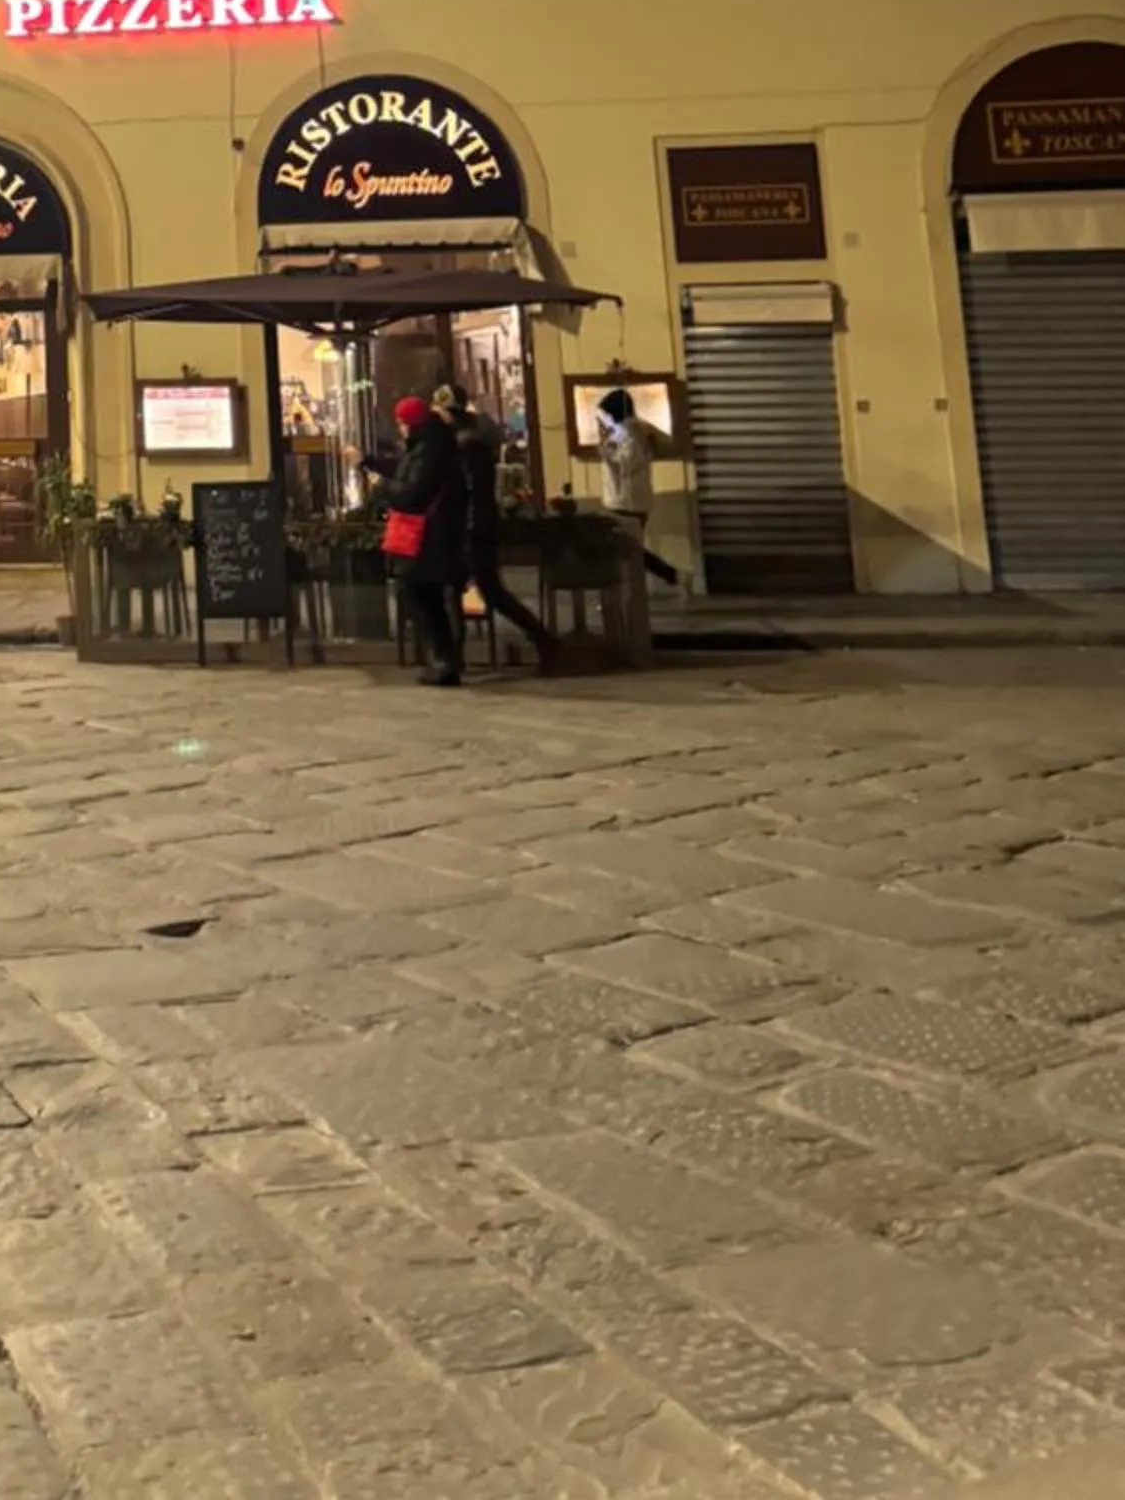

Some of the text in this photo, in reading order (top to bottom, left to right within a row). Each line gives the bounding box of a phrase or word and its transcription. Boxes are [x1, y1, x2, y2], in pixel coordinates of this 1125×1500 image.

[277, 90, 502, 193] RISTORANTE
[323, 160, 454, 209] lo Spuntino
